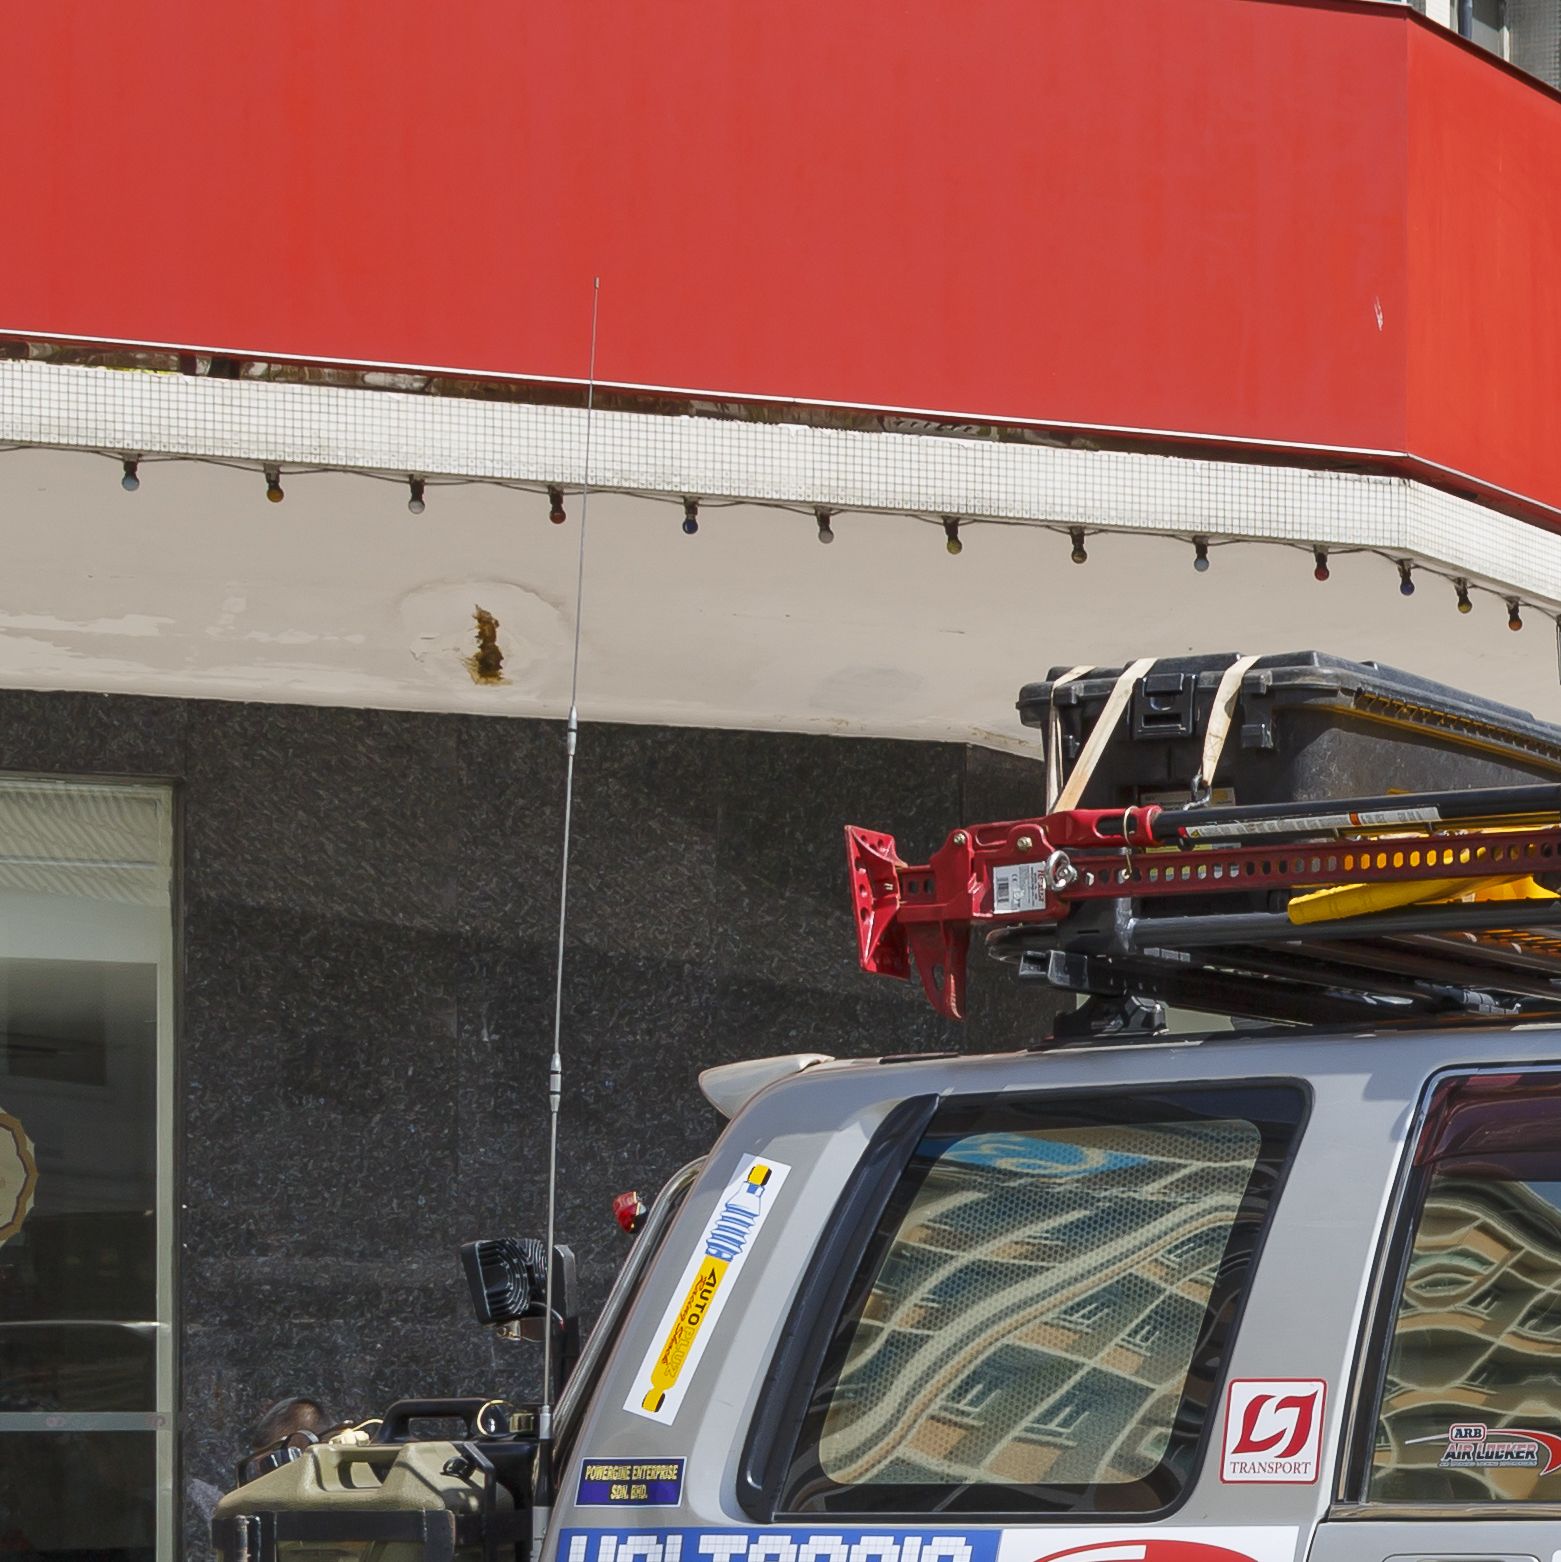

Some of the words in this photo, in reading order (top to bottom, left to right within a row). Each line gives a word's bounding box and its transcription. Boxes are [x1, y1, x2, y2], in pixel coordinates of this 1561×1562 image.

[1453, 1427, 1483, 1439] ARB
[1445, 1443, 1474, 1460] AIR
[1476, 1443, 1538, 1460] LOCKER
[632, 1464, 679, 1480] ENTERPRISE
[1230, 1461, 1312, 1475] TRANSPORT
